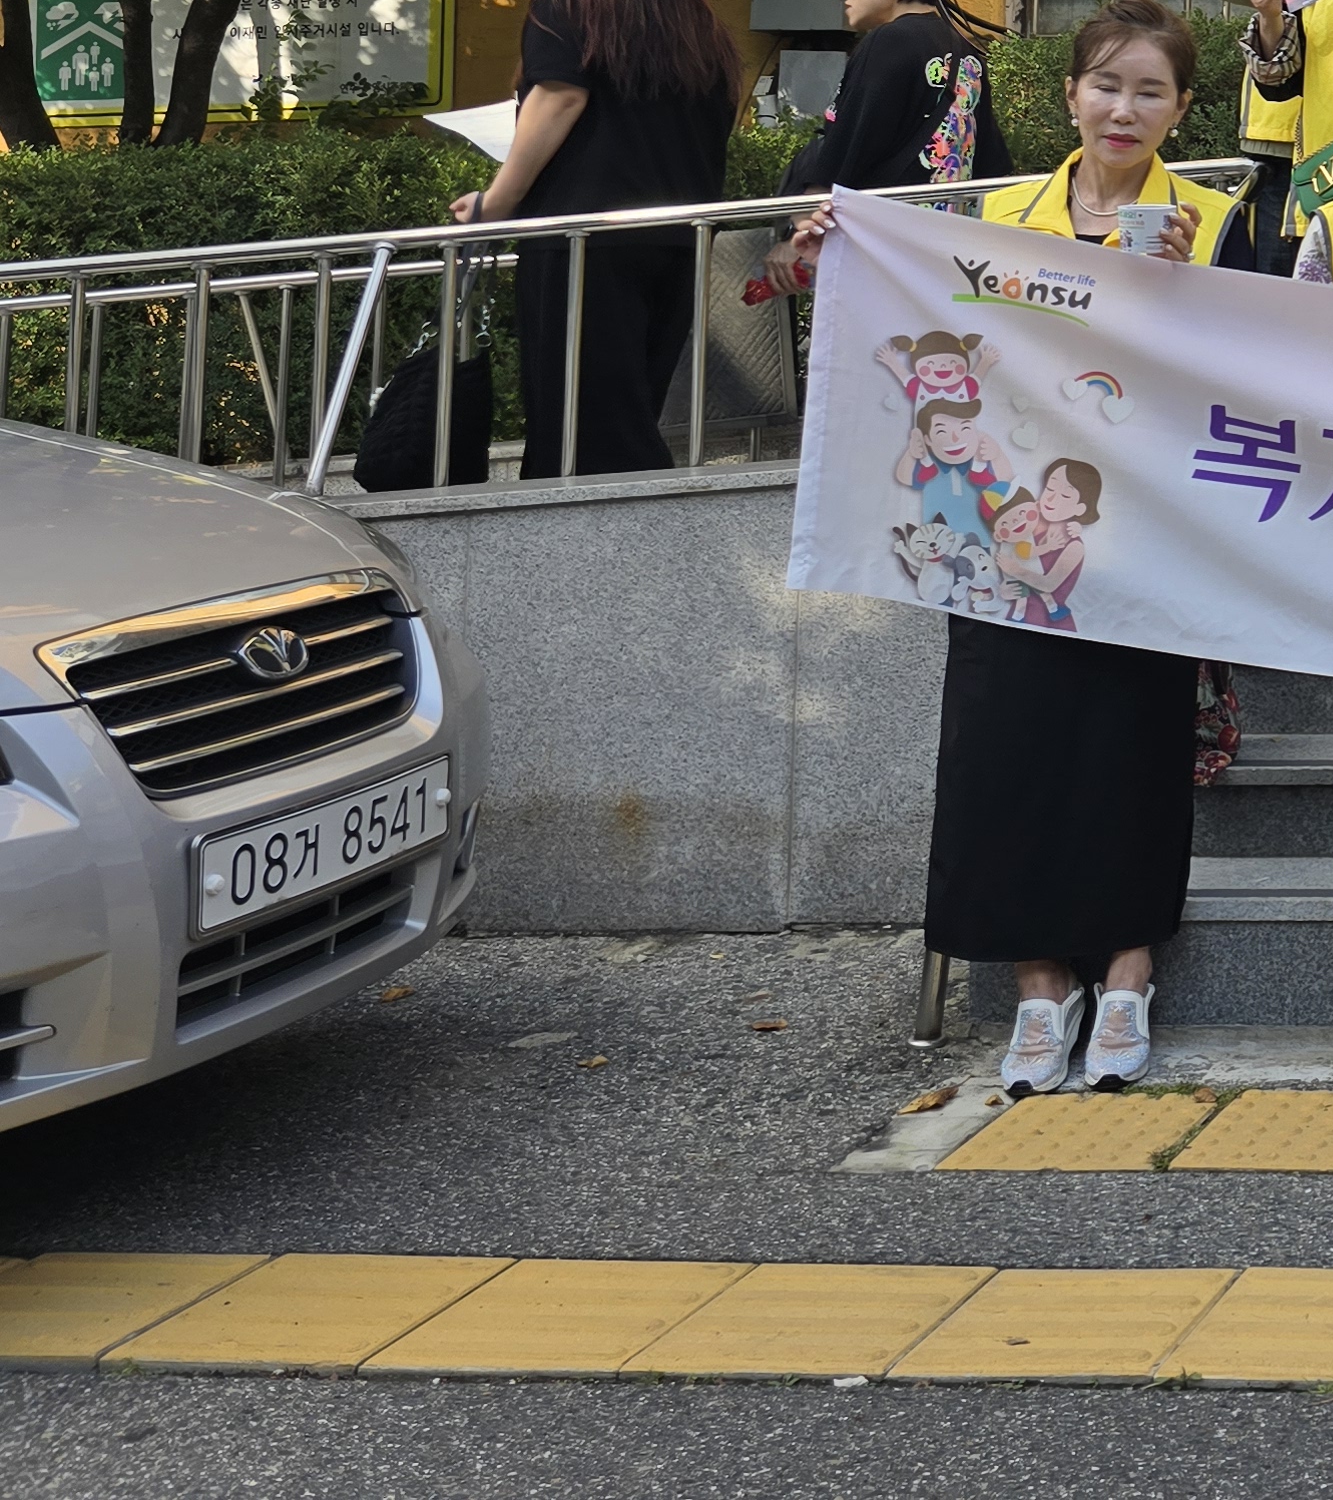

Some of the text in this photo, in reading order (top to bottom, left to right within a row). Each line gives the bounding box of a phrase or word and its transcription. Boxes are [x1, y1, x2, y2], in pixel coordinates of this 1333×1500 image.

[229, 24, 267, 40] 이재민
[357, 21, 400, 37] 입니다.
[953, 255, 1092, 310] Yeonsu
[1037, 267, 1097, 288] Better life
[230, 776, 430, 907] 08거 8541
